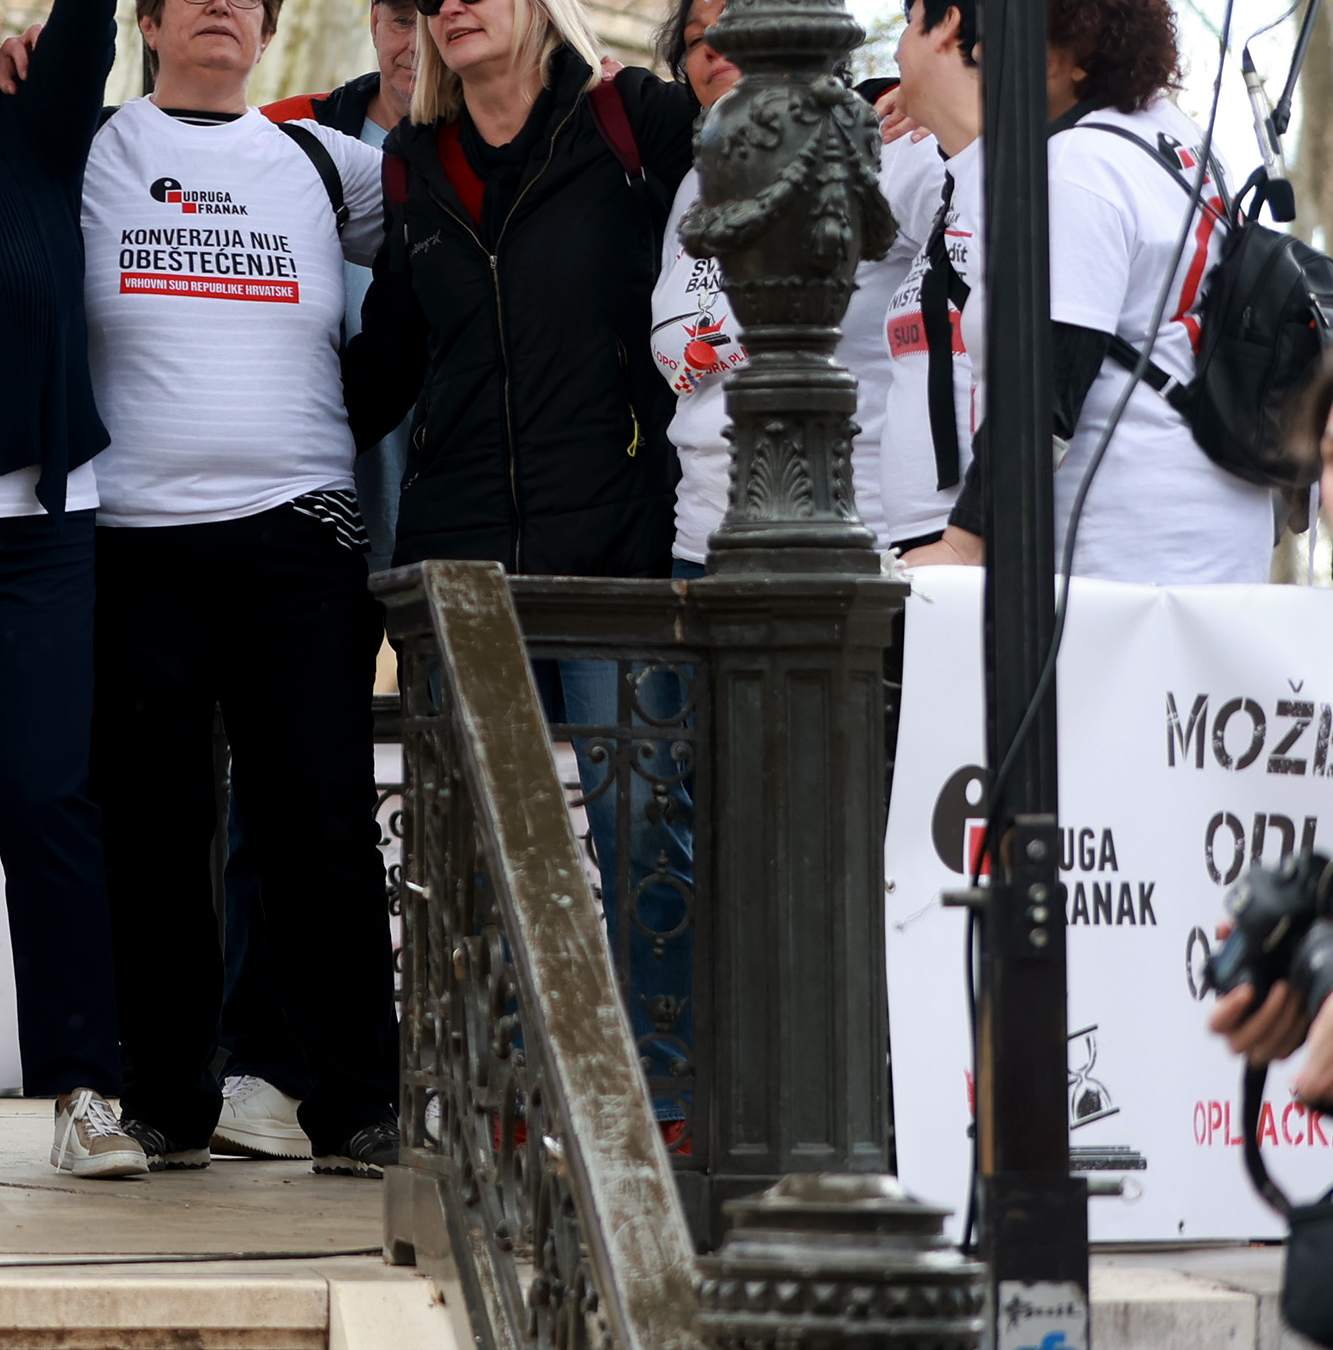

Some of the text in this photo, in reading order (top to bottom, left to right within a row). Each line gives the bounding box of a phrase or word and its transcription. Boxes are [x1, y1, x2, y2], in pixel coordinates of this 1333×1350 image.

[183, 190, 233, 203] UDRUGA
[198, 203, 248, 215] FRANAK
[120, 228, 293, 254] KONVERZIJA NIJE
[119, 247, 298, 279] OBEŠTEĆENJE!
[124, 278, 294, 298] VRHOVNI SUD REPUBLIKE HRVATSKE
[893, 323, 920, 348] SUD
